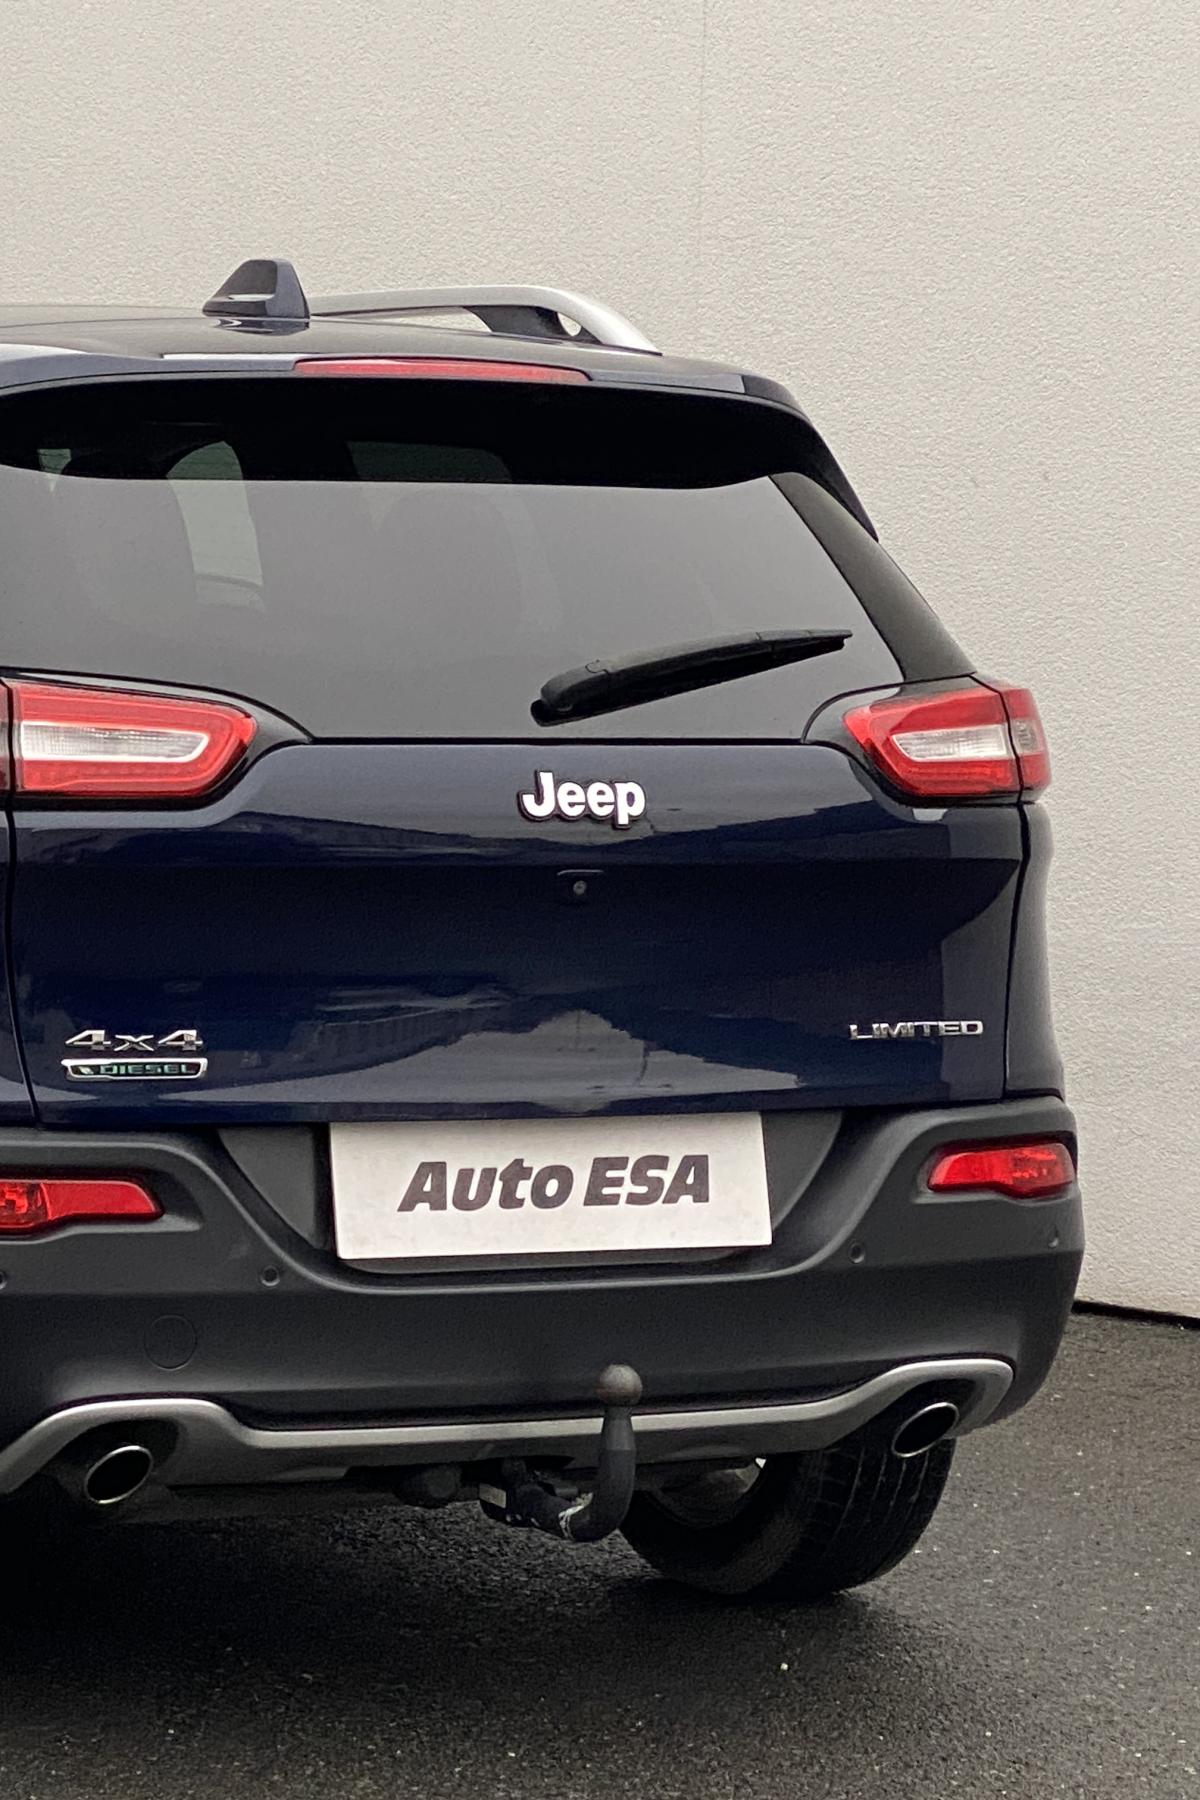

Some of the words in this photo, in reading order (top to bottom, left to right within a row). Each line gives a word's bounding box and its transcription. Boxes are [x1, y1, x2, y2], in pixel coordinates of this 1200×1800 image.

[519, 769, 647, 829] Jeep
[64, 1029, 203, 1051] 4x4
[849, 1020, 984, 1040] LIMITED
[100, 1064, 196, 1075] DIESEL
[397, 1157, 574, 1212] Auto
[583, 1154, 710, 1207] ESA
